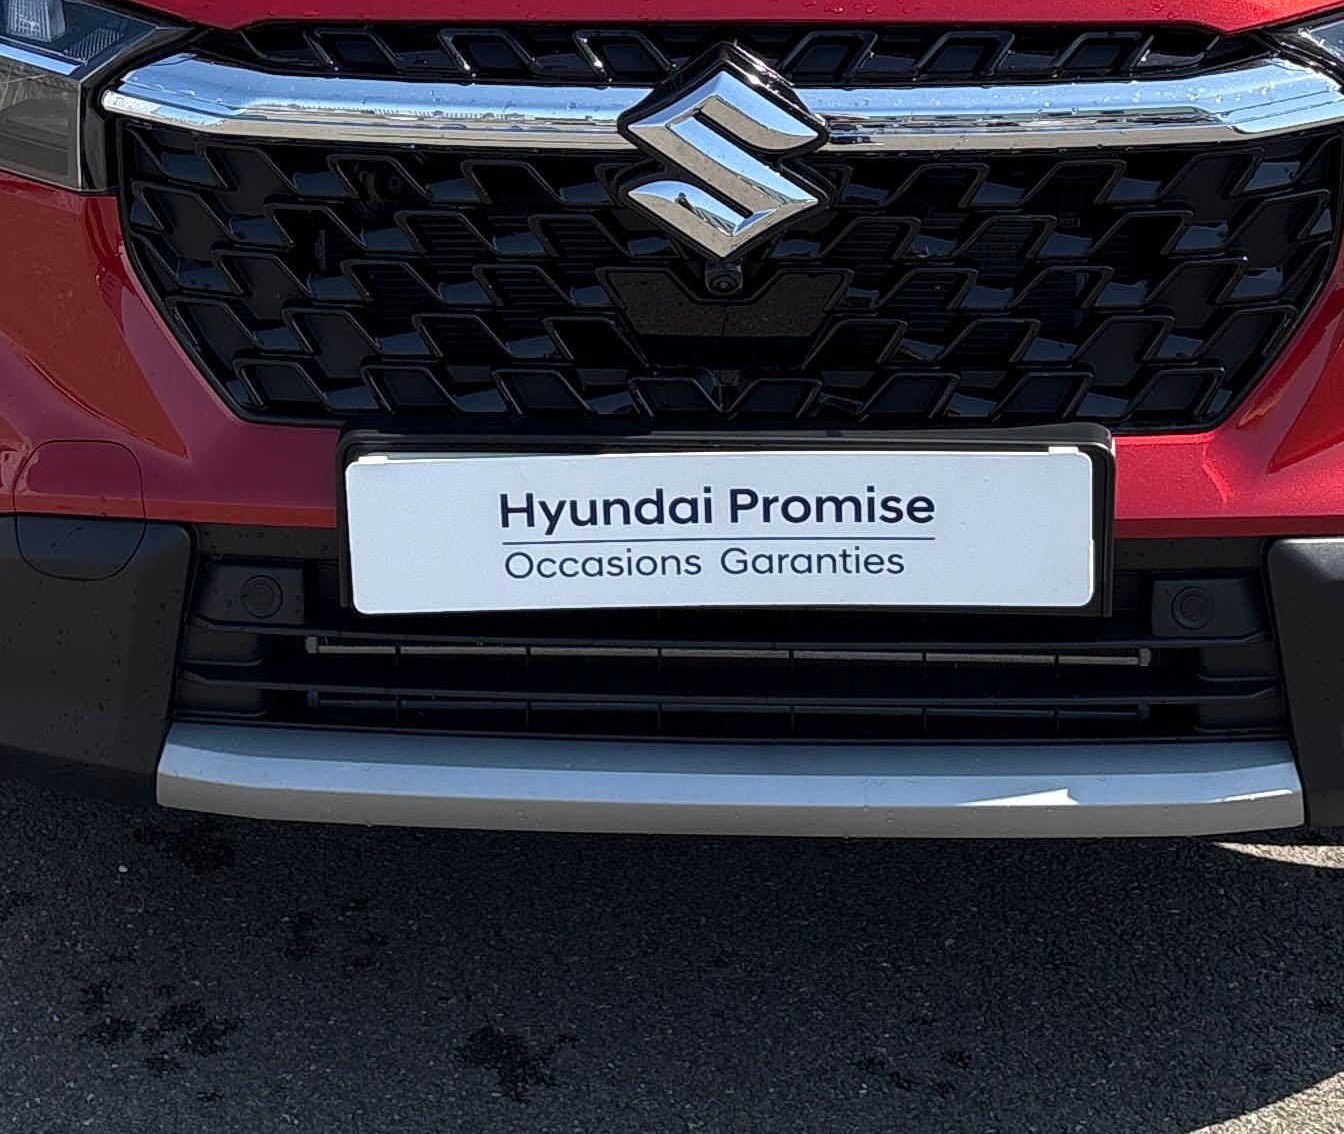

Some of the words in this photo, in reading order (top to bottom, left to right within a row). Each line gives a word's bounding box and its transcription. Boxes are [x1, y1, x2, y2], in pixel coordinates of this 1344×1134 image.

[500, 484, 715, 537] Hyundai
[728, 483, 937, 527] Promise
[503, 547, 703, 580] Occasions
[719, 544, 906, 577] Garanties
